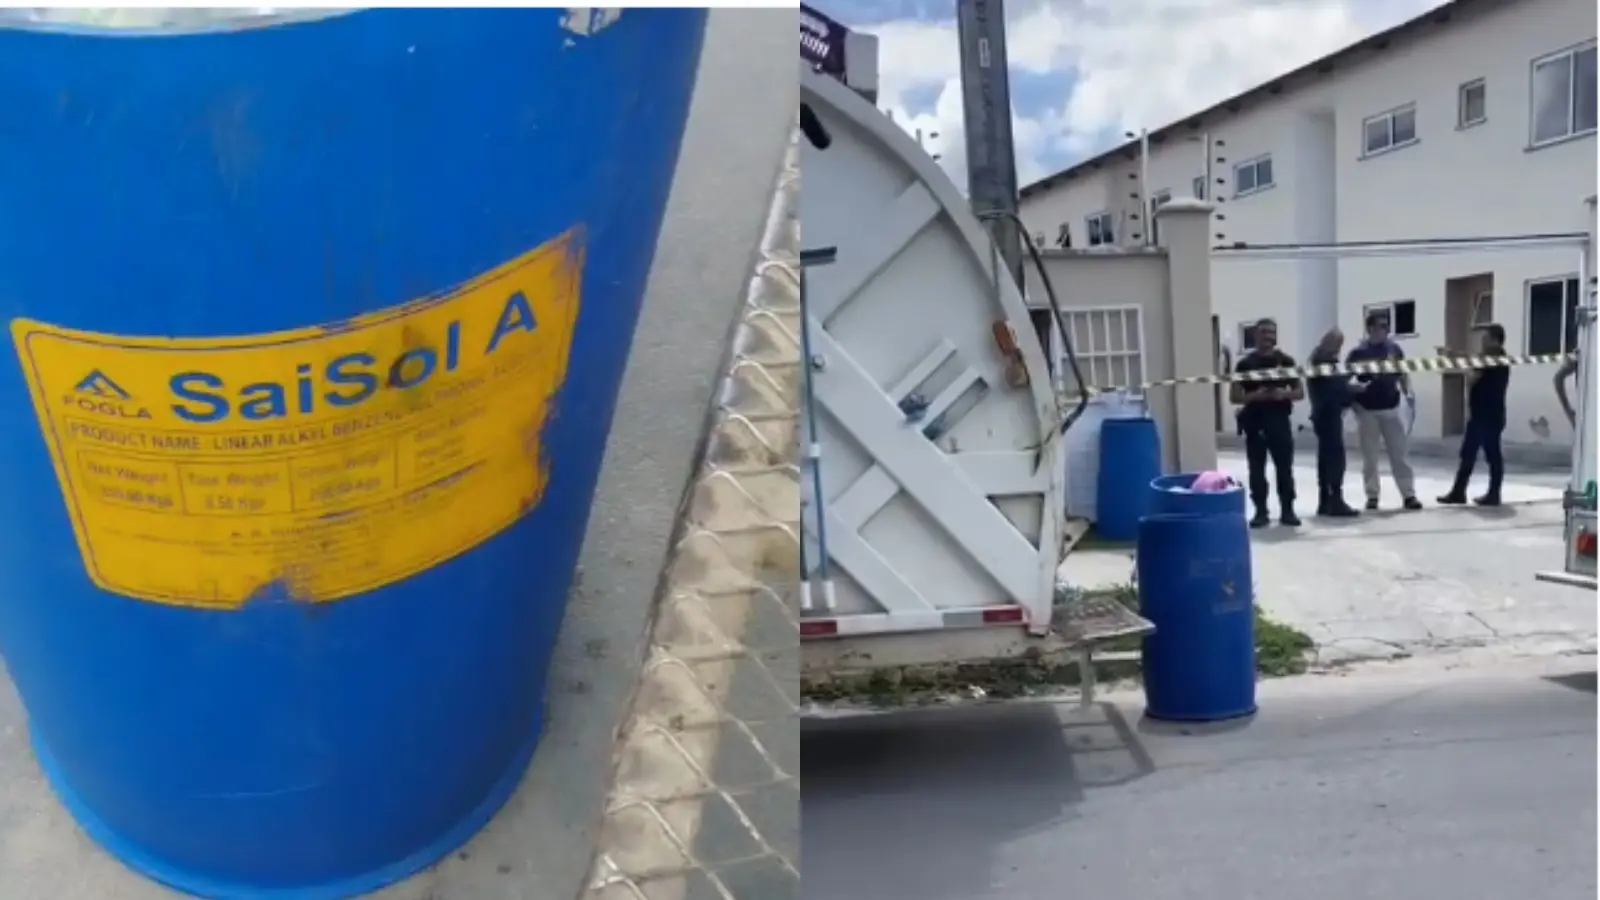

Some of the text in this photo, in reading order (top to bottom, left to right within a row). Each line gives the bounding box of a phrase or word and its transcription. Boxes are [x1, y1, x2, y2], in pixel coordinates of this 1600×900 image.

[169, 319, 461, 423] SaiSol
[484, 289, 538, 355] A
[70, 421, 147, 449] PRODUCT
[152, 434, 202, 451] NAME
[212, 434, 274, 451] LINEAR
[277, 427, 326, 446] ALKYL
